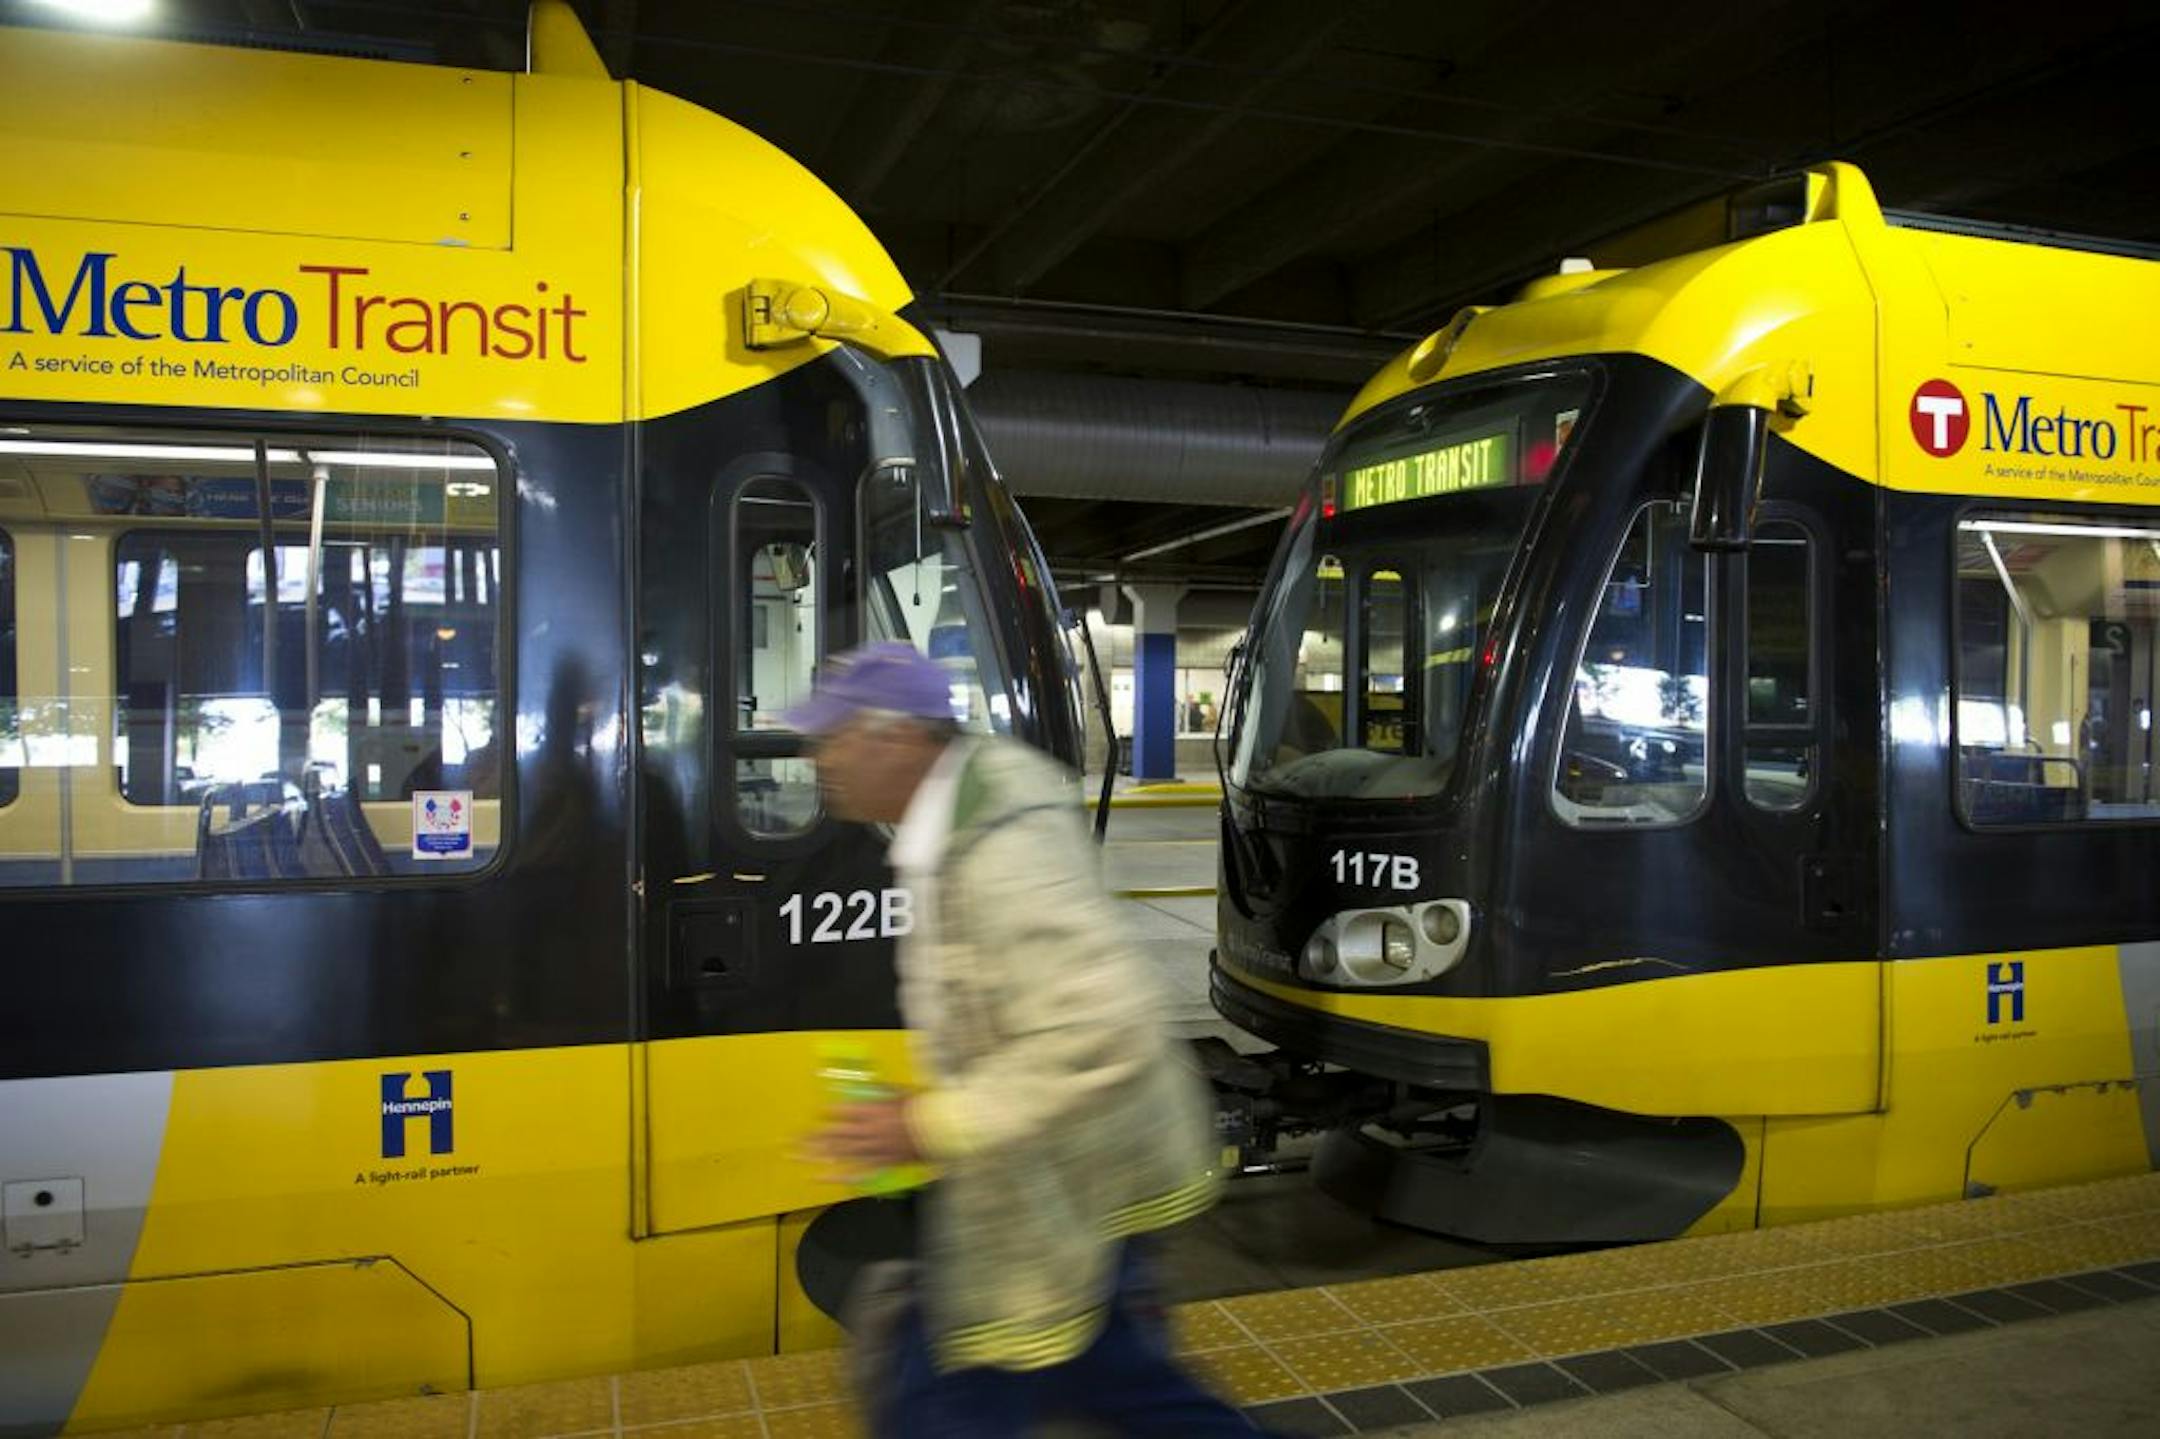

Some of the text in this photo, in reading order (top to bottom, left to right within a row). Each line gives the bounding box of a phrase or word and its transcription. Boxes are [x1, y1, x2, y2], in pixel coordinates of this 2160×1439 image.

[0, 247, 588, 363] Metro Transit
[8, 351, 419, 388] A service of the Metropolitan Council
[1980, 392, 2116, 460] Metro
[1354, 438, 1493, 507] METRO TRANSIT
[1330, 849, 1421, 891] 117B
[779, 887, 914, 945] 122B
[382, 1097, 453, 1115] Hennepin
[354, 1163, 480, 1185] A light-rail partner
